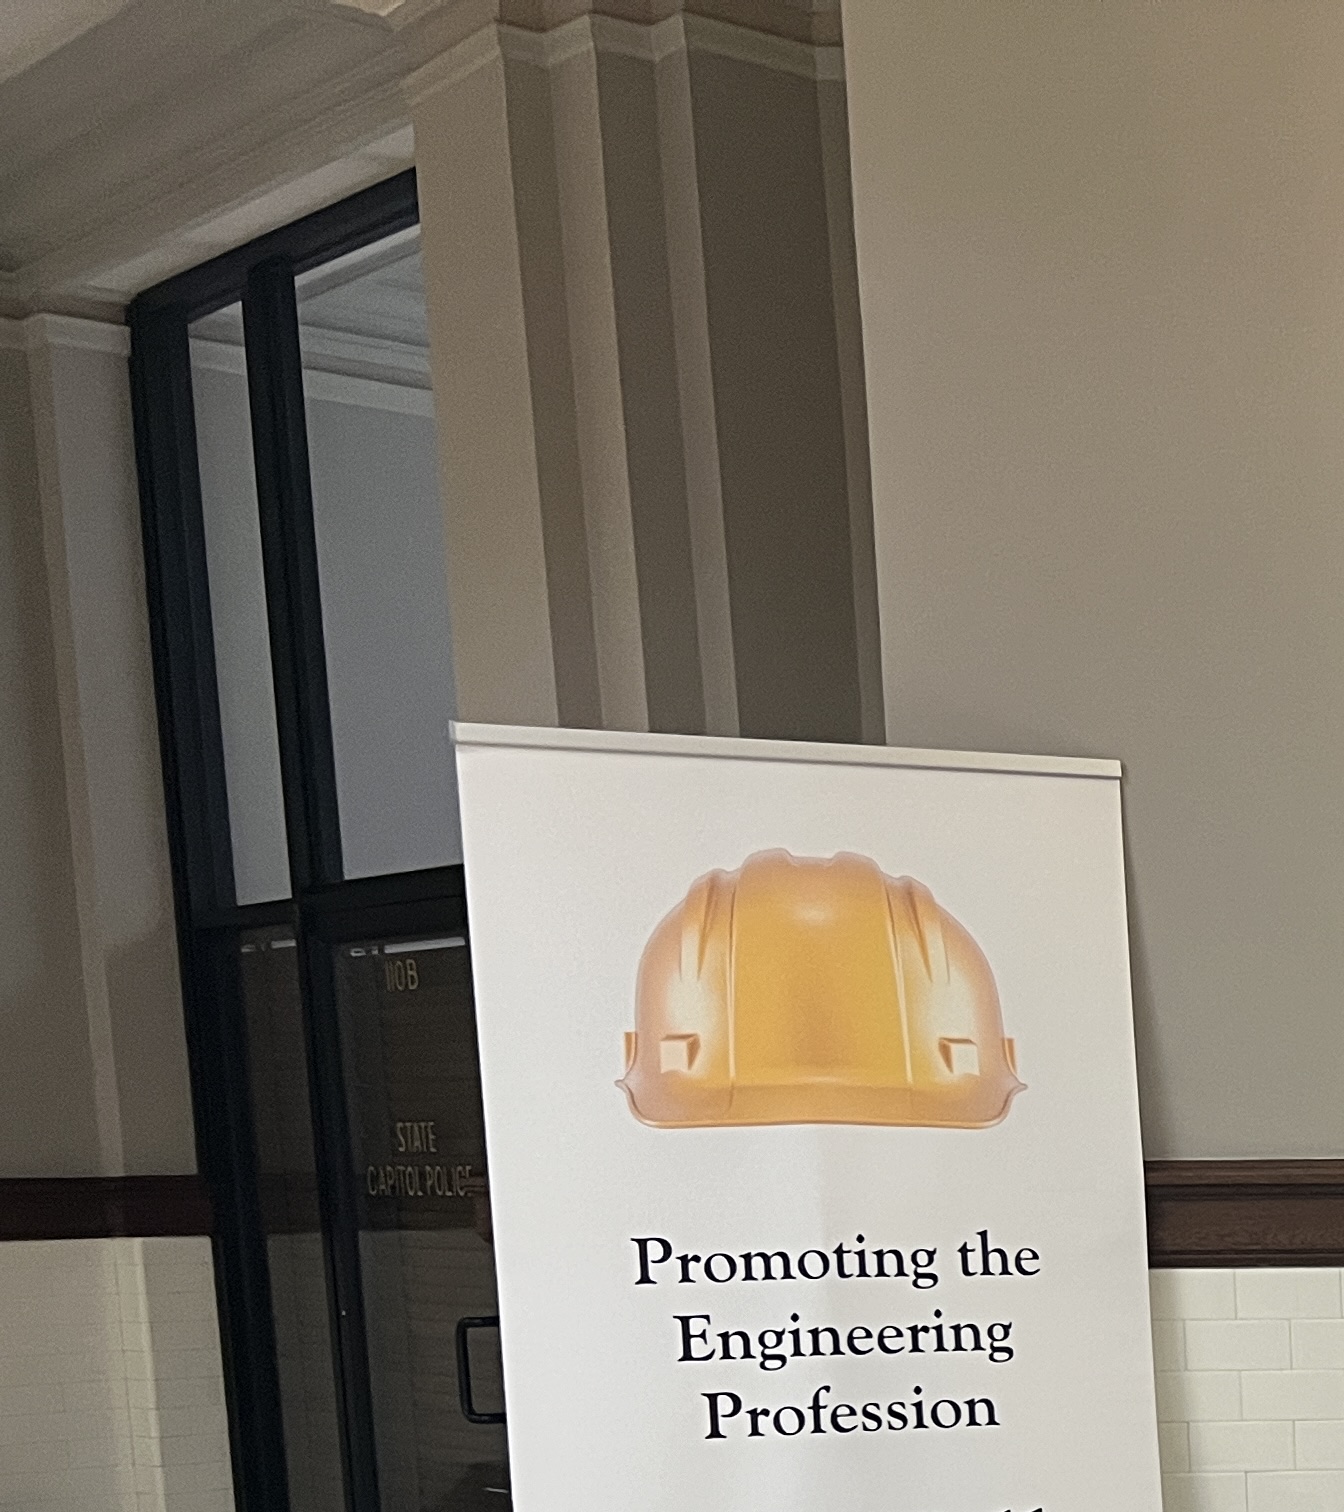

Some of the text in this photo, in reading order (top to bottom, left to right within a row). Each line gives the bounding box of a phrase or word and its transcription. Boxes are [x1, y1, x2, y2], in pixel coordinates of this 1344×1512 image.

[396, 1122, 437, 1152] STATE
[367, 1165, 423, 1197] CAPITOL
[630, 1229, 1041, 1290] Promoting the
[672, 1308, 1014, 1372] Engineering
[700, 1385, 1001, 1440] Profession
